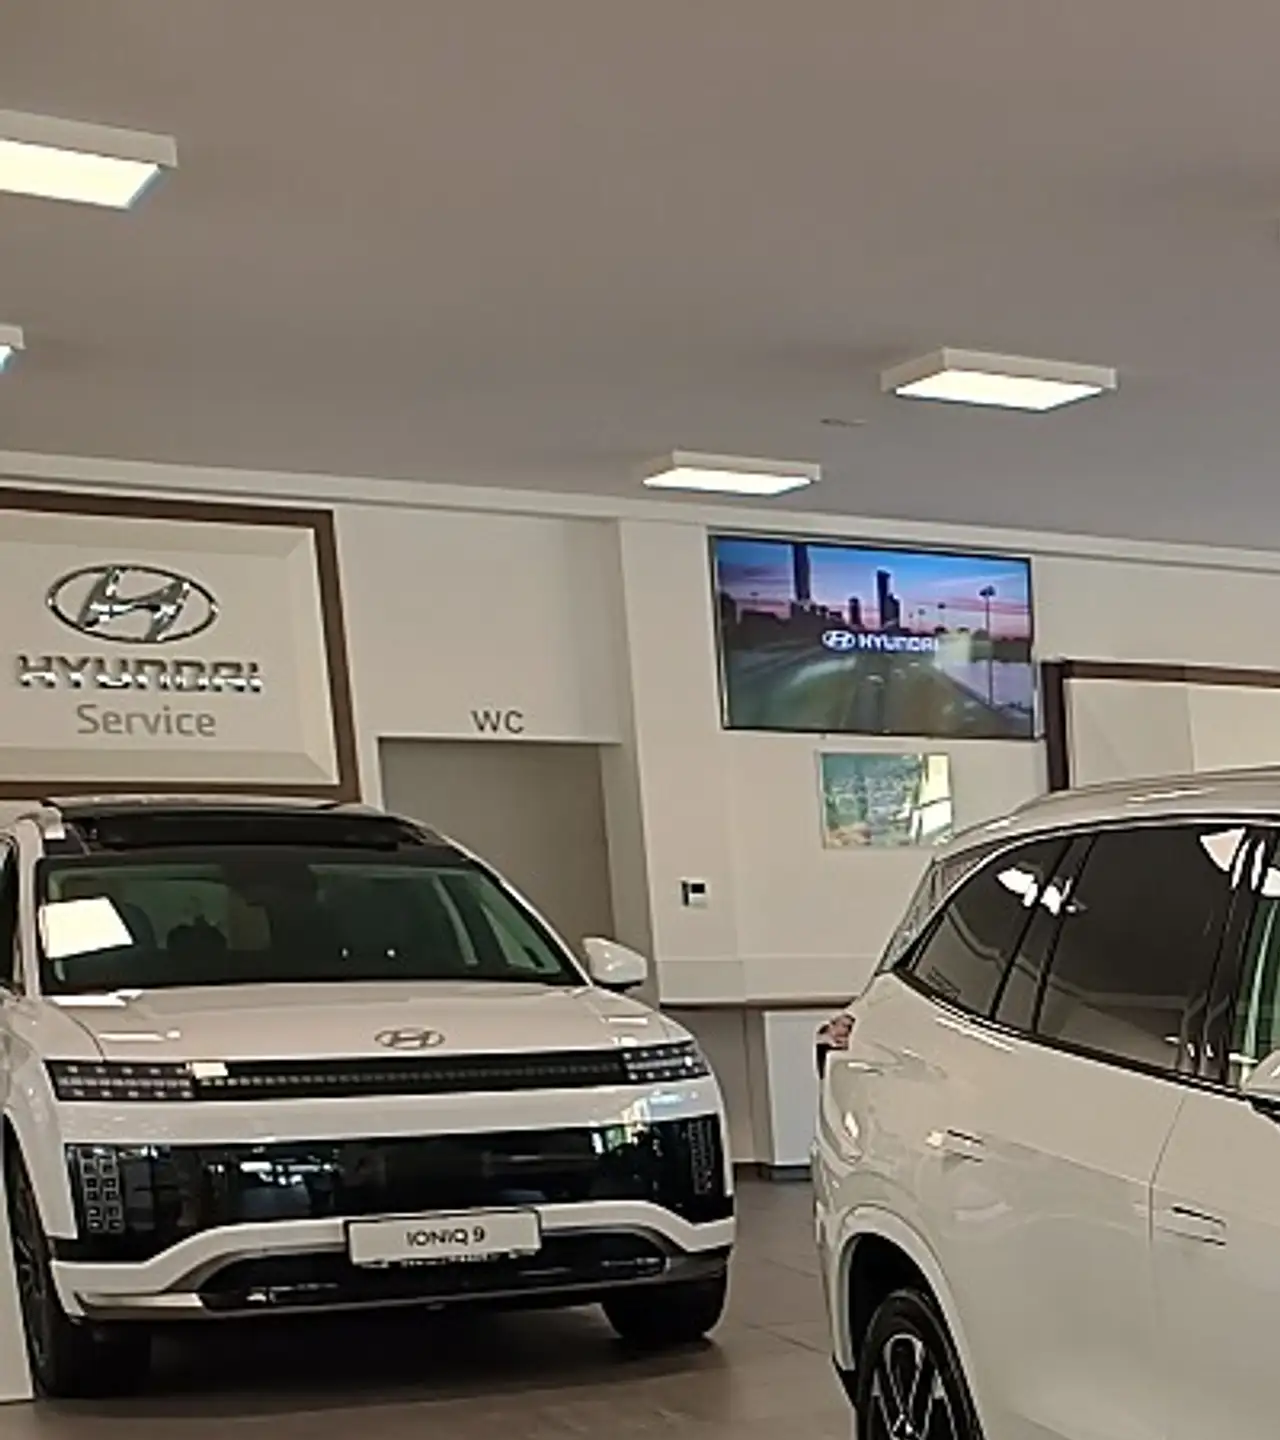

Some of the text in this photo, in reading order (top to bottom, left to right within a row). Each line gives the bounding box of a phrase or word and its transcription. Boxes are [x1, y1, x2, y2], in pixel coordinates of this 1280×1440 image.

[858, 633, 939, 652] HYUNDAI
[18, 655, 263, 692] HYUNDAI
[77, 703, 217, 737] Service
[470, 710, 525, 734] WC
[406, 1226, 486, 1247] IONIQ 9
